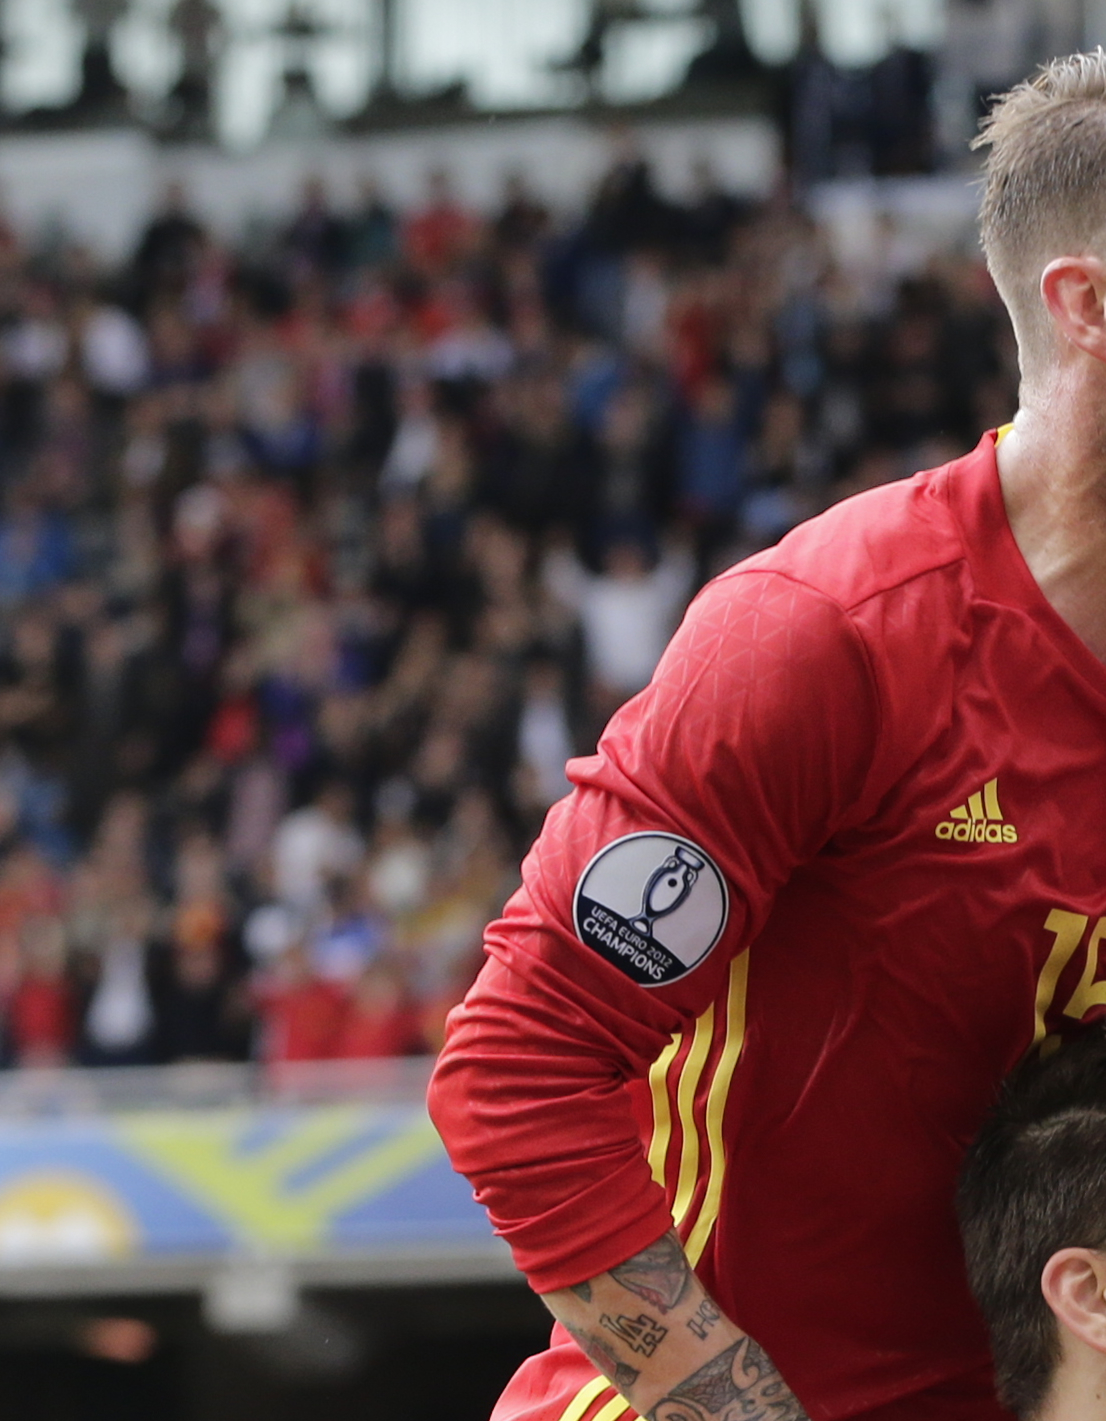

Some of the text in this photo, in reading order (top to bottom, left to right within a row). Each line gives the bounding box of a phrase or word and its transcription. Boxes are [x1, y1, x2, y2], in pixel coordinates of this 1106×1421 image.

[935, 818, 1018, 844] adidas
[582, 916, 666, 981] CHAMPIONS
[590, 905, 674, 969] UEFA EURO 2012
